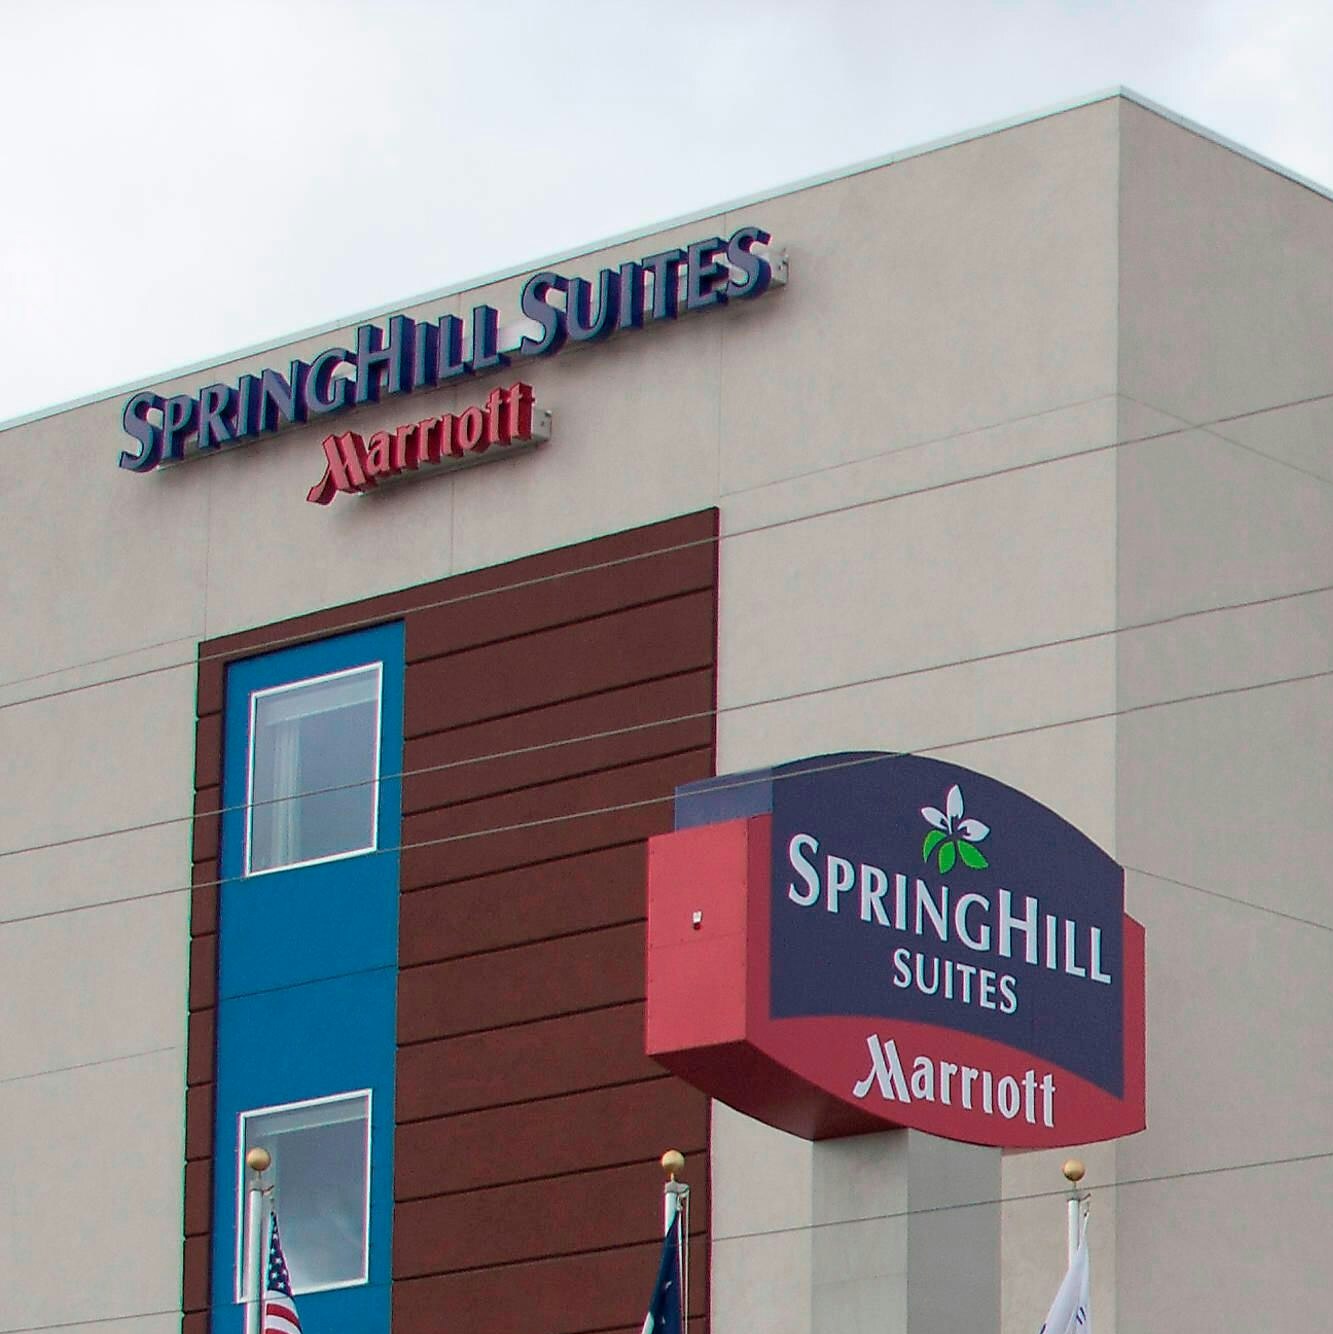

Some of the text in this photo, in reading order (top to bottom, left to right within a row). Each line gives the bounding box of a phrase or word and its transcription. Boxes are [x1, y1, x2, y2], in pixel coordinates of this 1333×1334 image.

[118, 226, 773, 473] SPRINGHILL SUITES
[305, 381, 533, 505] Marriott
[787, 832, 1113, 985] SPRINGHILL
[892, 947, 1019, 1015] SUITES
[852, 1032, 1058, 1129] Marriott
